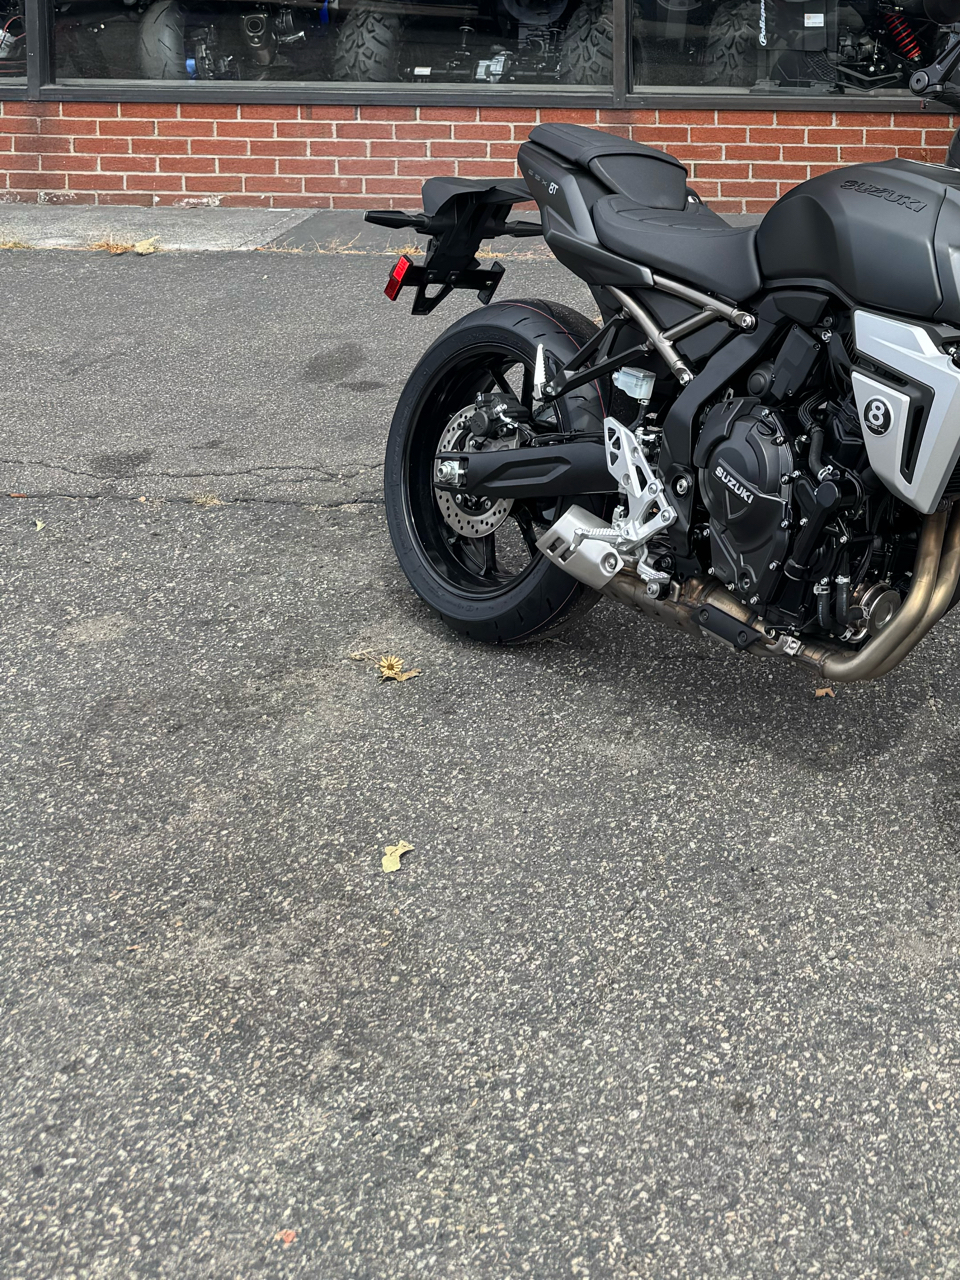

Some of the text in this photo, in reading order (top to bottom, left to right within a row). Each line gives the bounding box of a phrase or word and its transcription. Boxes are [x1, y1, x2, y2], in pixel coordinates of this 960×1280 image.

[840, 180, 928, 213] SUZUKI
[868, 401, 885, 426] 8
[715, 466, 755, 504] SUZUKI
